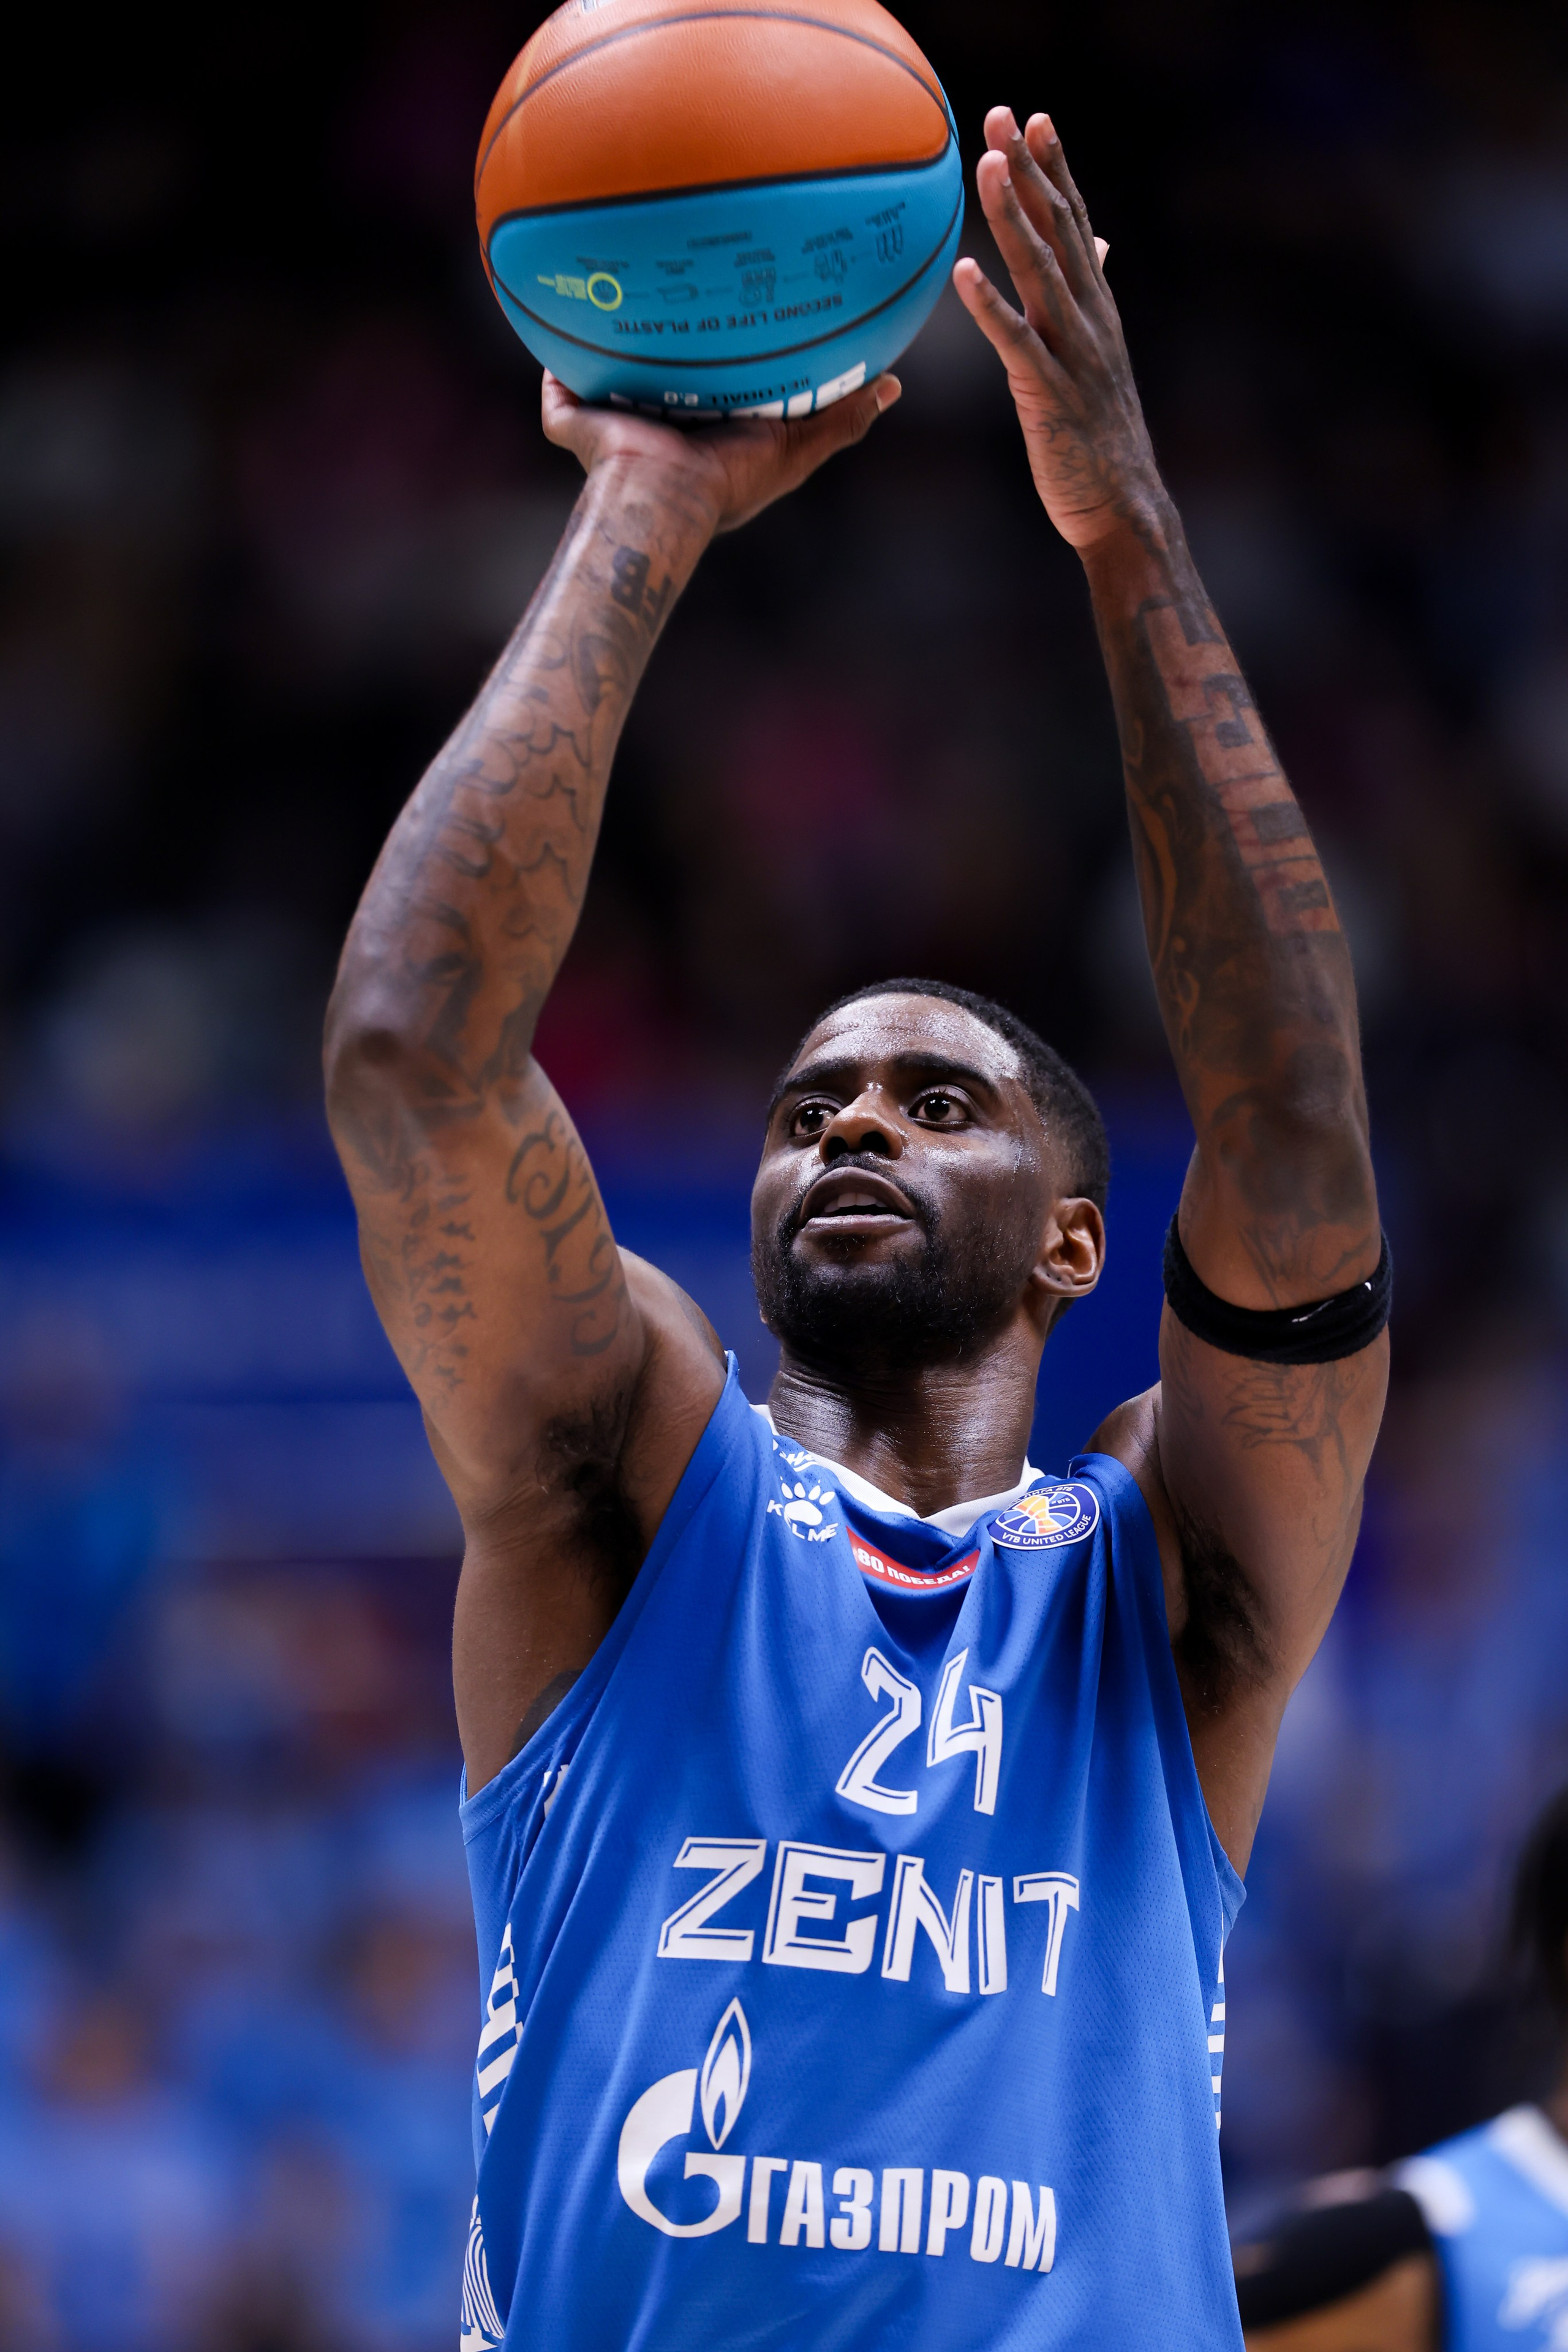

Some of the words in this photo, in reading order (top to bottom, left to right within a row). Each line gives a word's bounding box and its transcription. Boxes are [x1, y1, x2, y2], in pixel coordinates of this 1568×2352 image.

[726, 311, 767, 330] LIFE
[774, 293, 843, 322] SECOND
[614, 319, 689, 334] PLASTIC
[697, 317, 720, 332] OF
[1023, 1488, 1053, 1498] ЛИГА
[1001, 1532, 1021, 1544] VTB
[1023, 1534, 1064, 1545] UNITED
[1064, 1514, 1091, 1538] LEAGUE
[858, 1548, 884, 1573] 80
[887, 1565, 970, 1585] ПОБЕДА!
[835, 1646, 1003, 1815] 24
[657, 1837, 1079, 1997] ZENIT
[747, 2156, 1057, 2273] ГАЗПРОМ
